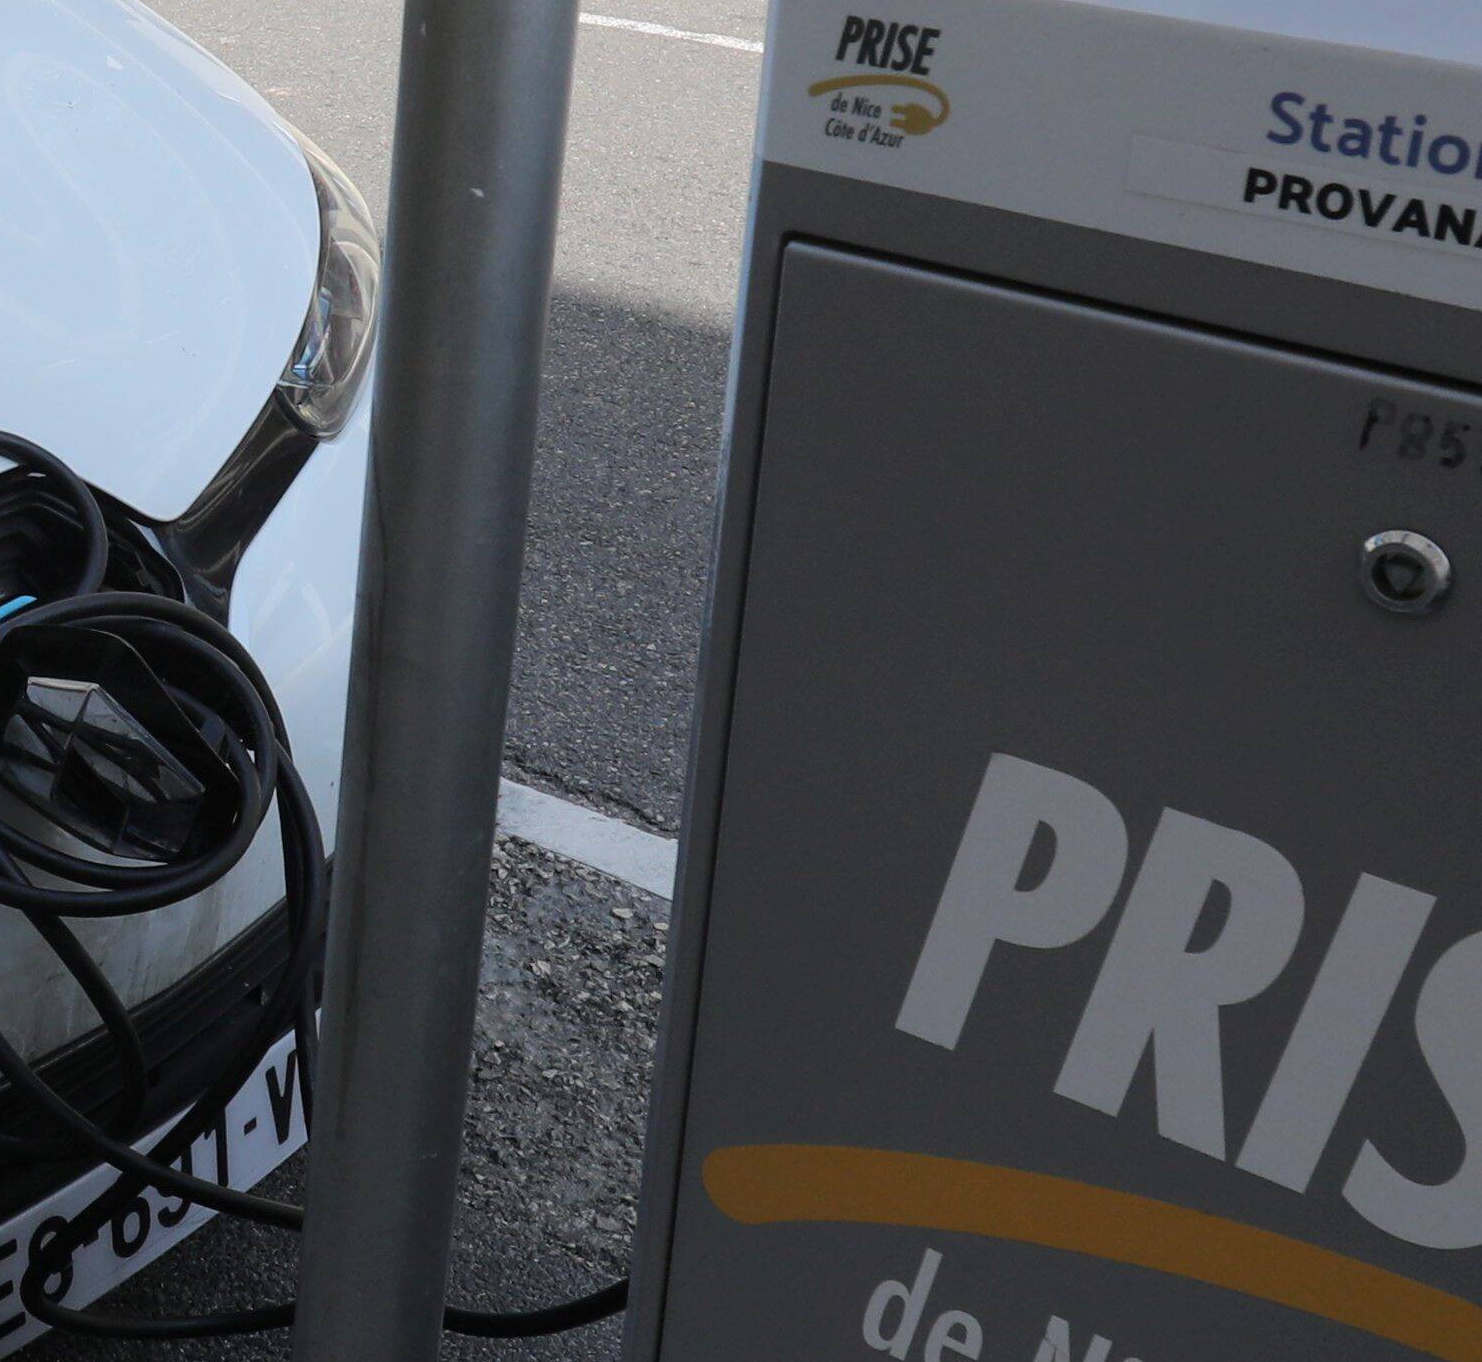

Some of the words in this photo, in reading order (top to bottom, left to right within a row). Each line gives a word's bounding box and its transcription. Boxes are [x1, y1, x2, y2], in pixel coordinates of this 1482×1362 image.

[835, 15, 941, 76] PRISE
[830, 92, 848, 113] de
[851, 96, 883, 119] Nice
[825, 117, 855, 140] Côte
[857, 123, 905, 149] d'Azur
